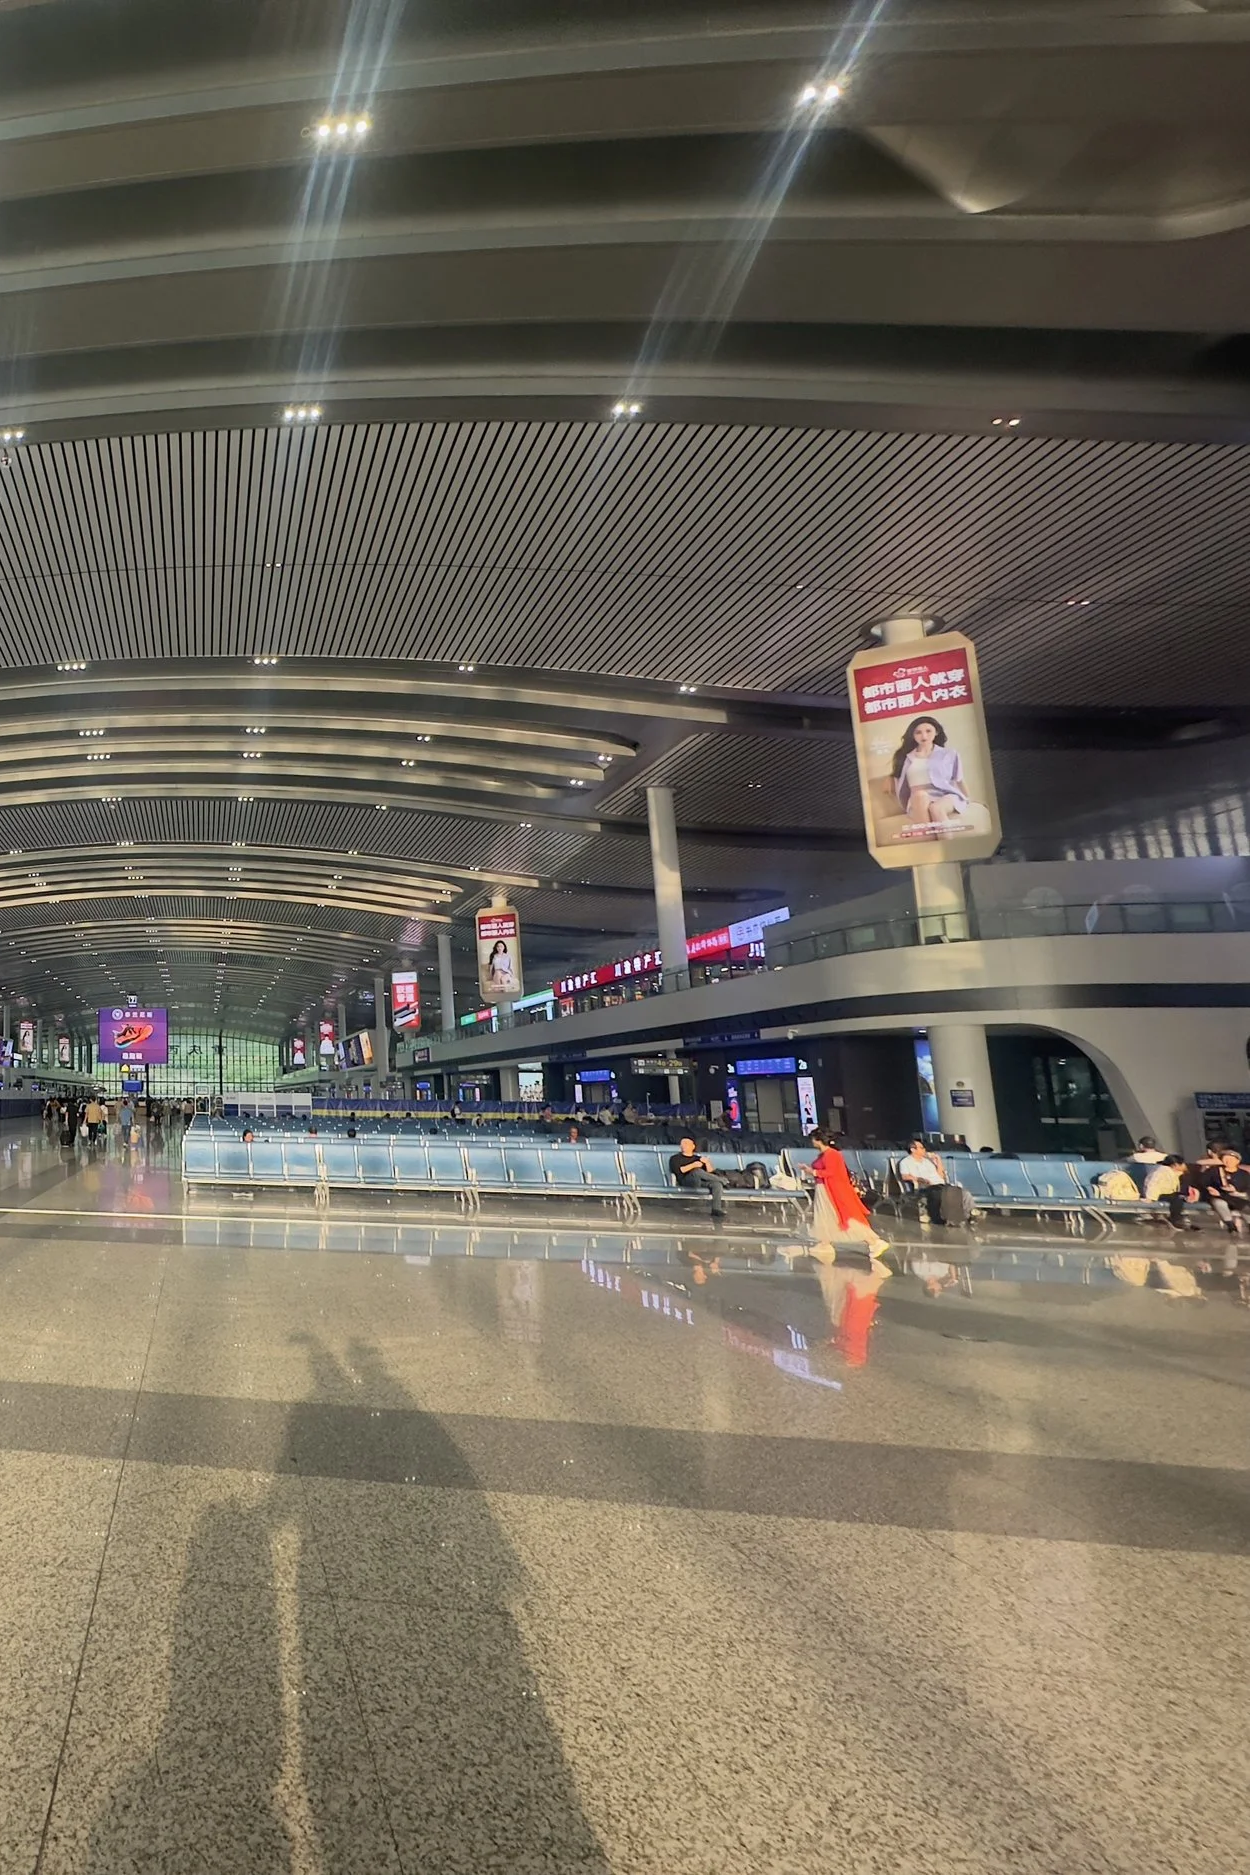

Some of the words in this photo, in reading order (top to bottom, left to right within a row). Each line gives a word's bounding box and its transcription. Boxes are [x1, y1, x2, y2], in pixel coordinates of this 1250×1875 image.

[862, 668, 964, 699] 都市丽人就穿
[864, 684, 967, 715] 都市丽人内衣
